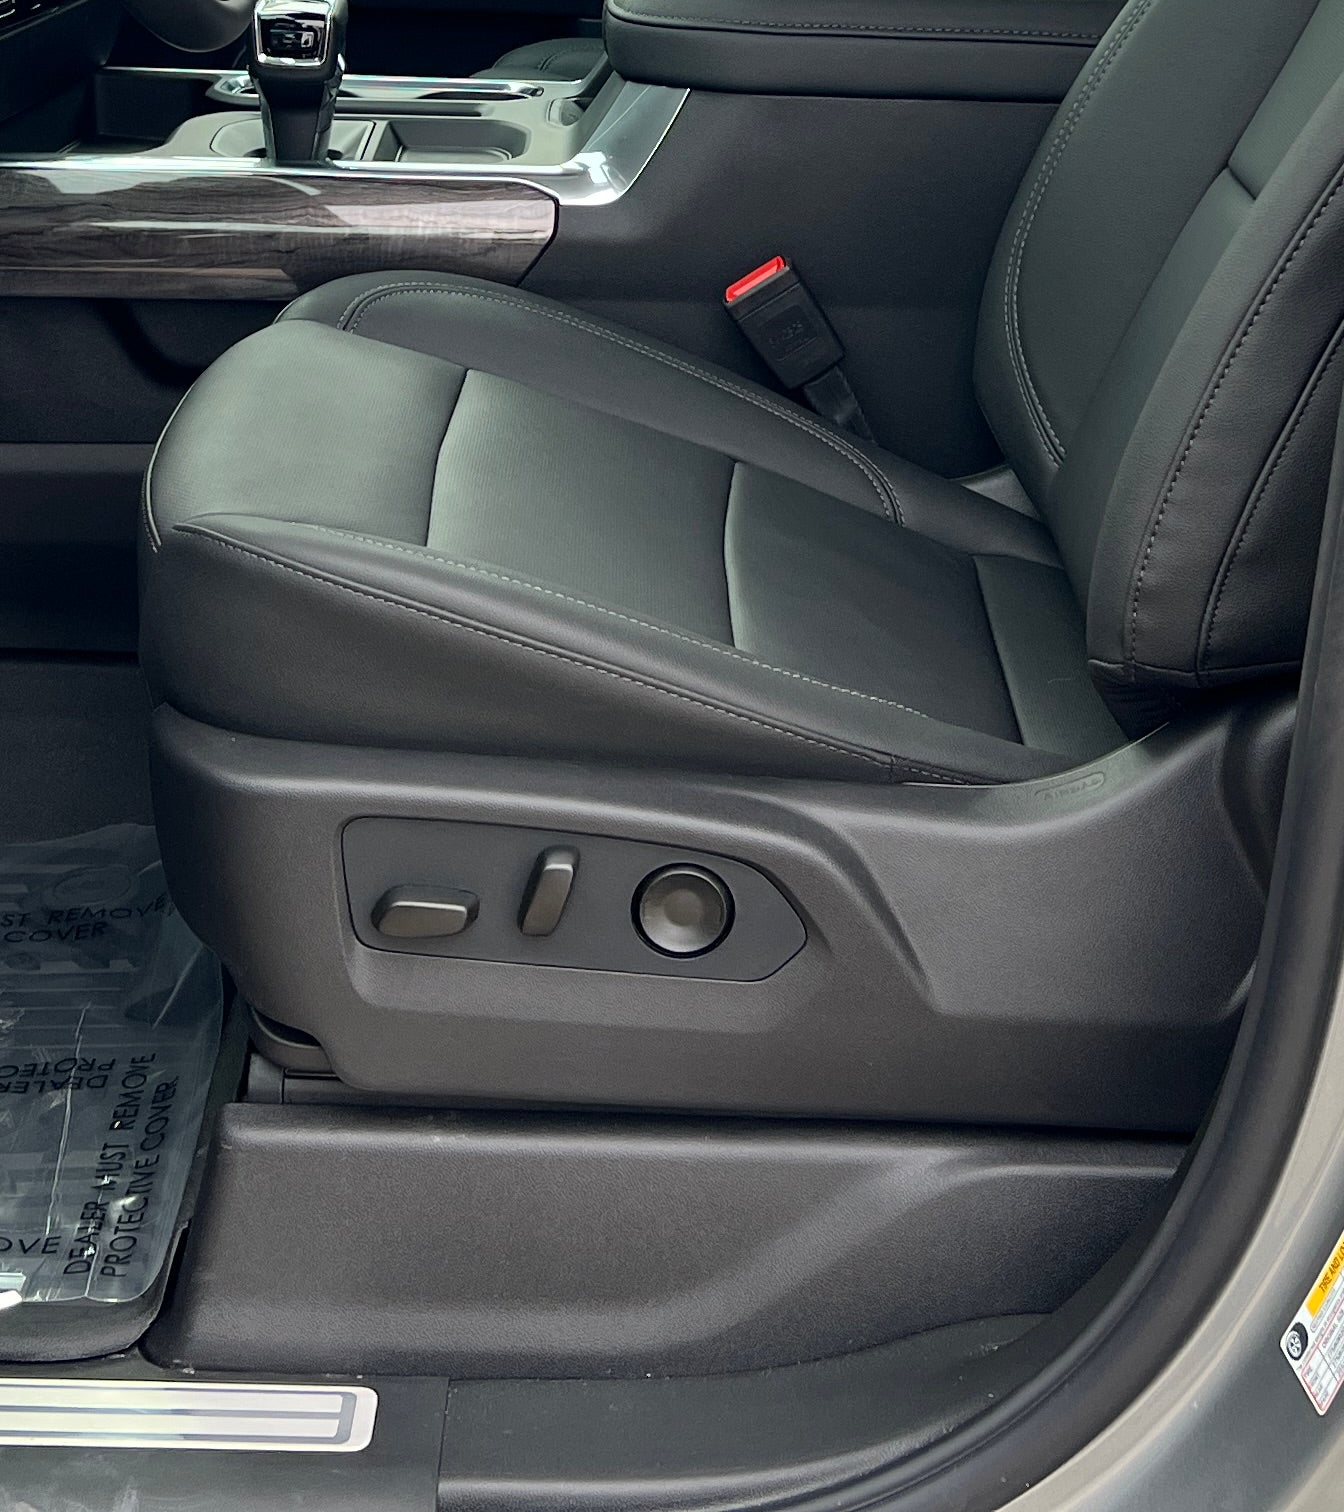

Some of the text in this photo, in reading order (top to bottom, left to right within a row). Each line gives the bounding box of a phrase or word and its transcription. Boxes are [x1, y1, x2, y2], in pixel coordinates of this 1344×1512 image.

[2, 922, 106, 943] COVER
[63, 1053, 156, 1274] DEALER MUST REMOVE
[100, 1075, 180, 1278] PROTECTIVE COVER
[1327, 1254, 1341, 1277] AND
